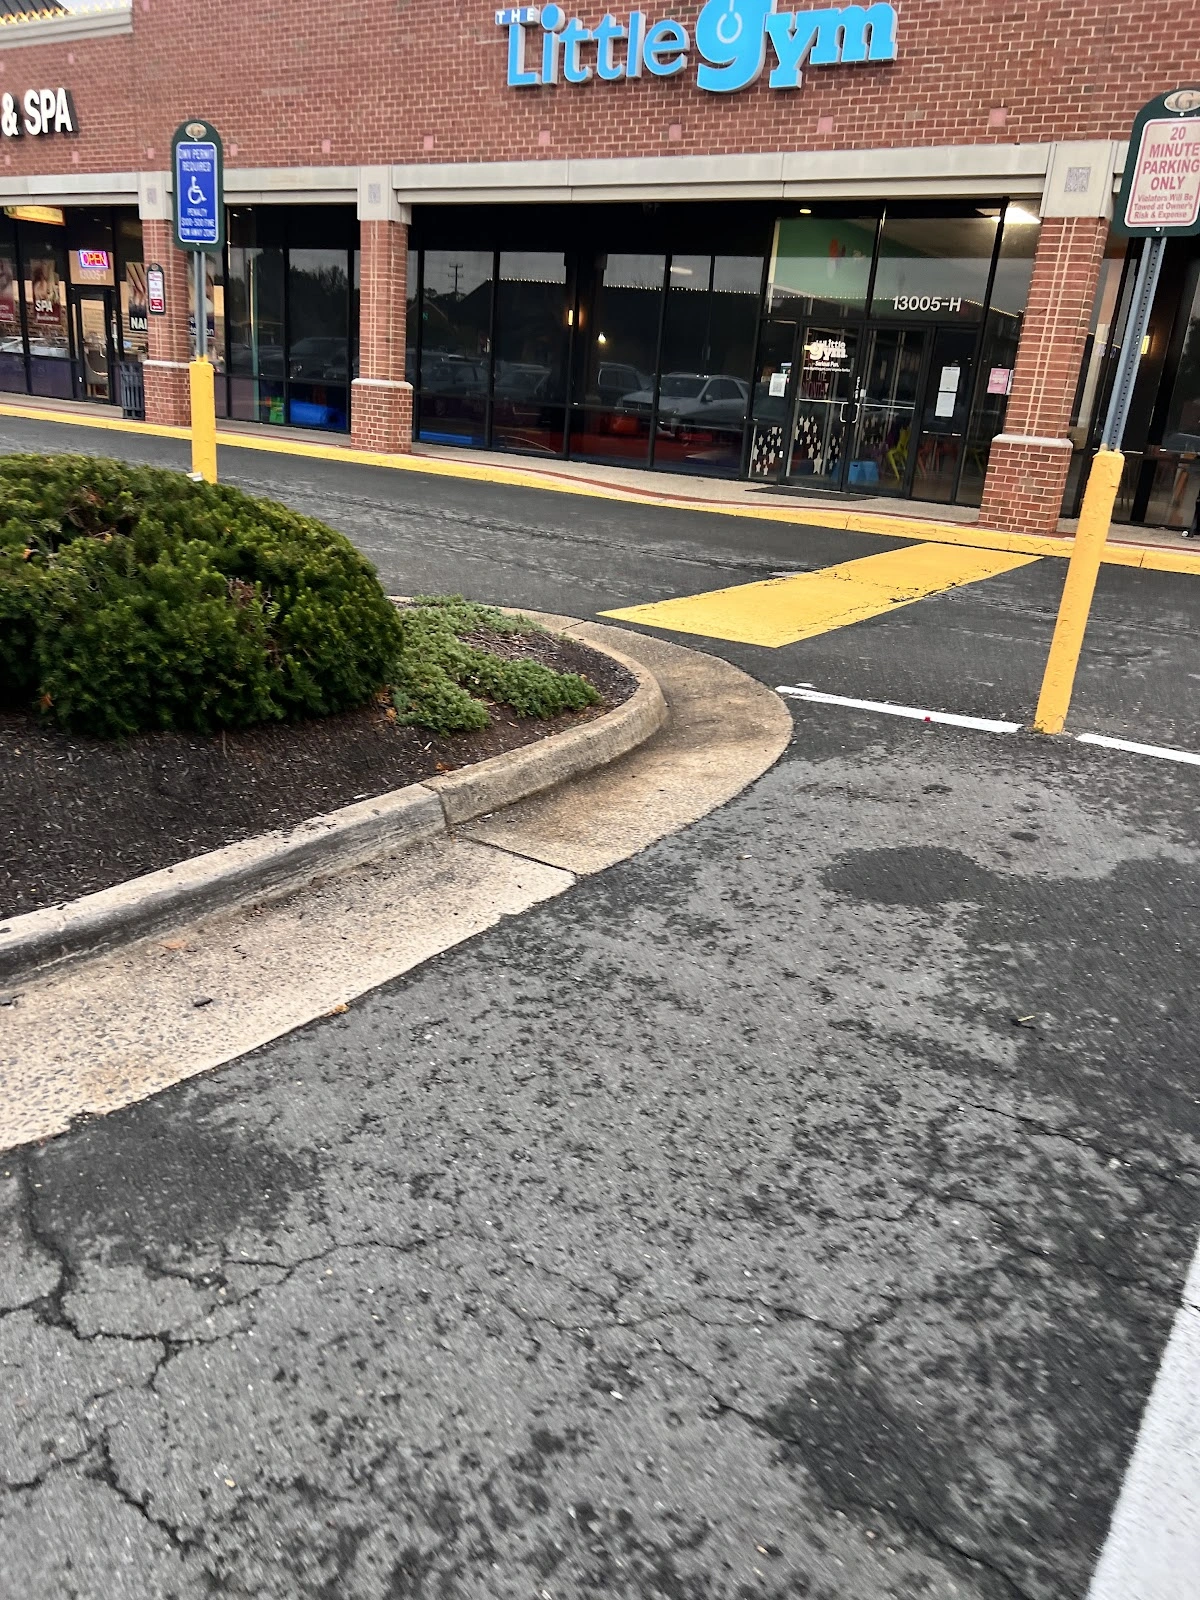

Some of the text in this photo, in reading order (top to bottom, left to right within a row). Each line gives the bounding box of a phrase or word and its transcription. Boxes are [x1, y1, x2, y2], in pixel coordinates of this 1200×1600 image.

[496, 0, 898, 93] THE Little gym
[2, 87, 74, 137] & SPA
[1170, 126, 1187, 141] 20
[192, 148, 214, 160] PERMIT
[1149, 142, 1200, 158] MINUTE
[182, 161, 212, 172] REQUIRED
[1143, 159, 1200, 175] PARKING
[1151, 176, 1186, 191] ONLY
[1138, 193, 1194, 203] Violators Will Be
[187, 207, 207, 217] PENALTY
[1134, 202, 1193, 211] Towed at Owner's
[1134, 211, 1187, 220] Risk & Expense
[203, 228, 216, 238] ZONE
[82, 252, 106, 266] OPEN
[35, 299, 53, 313] SPA
[892, 295, 962, 312] 13005-H
[824, 338, 846, 349] Little
